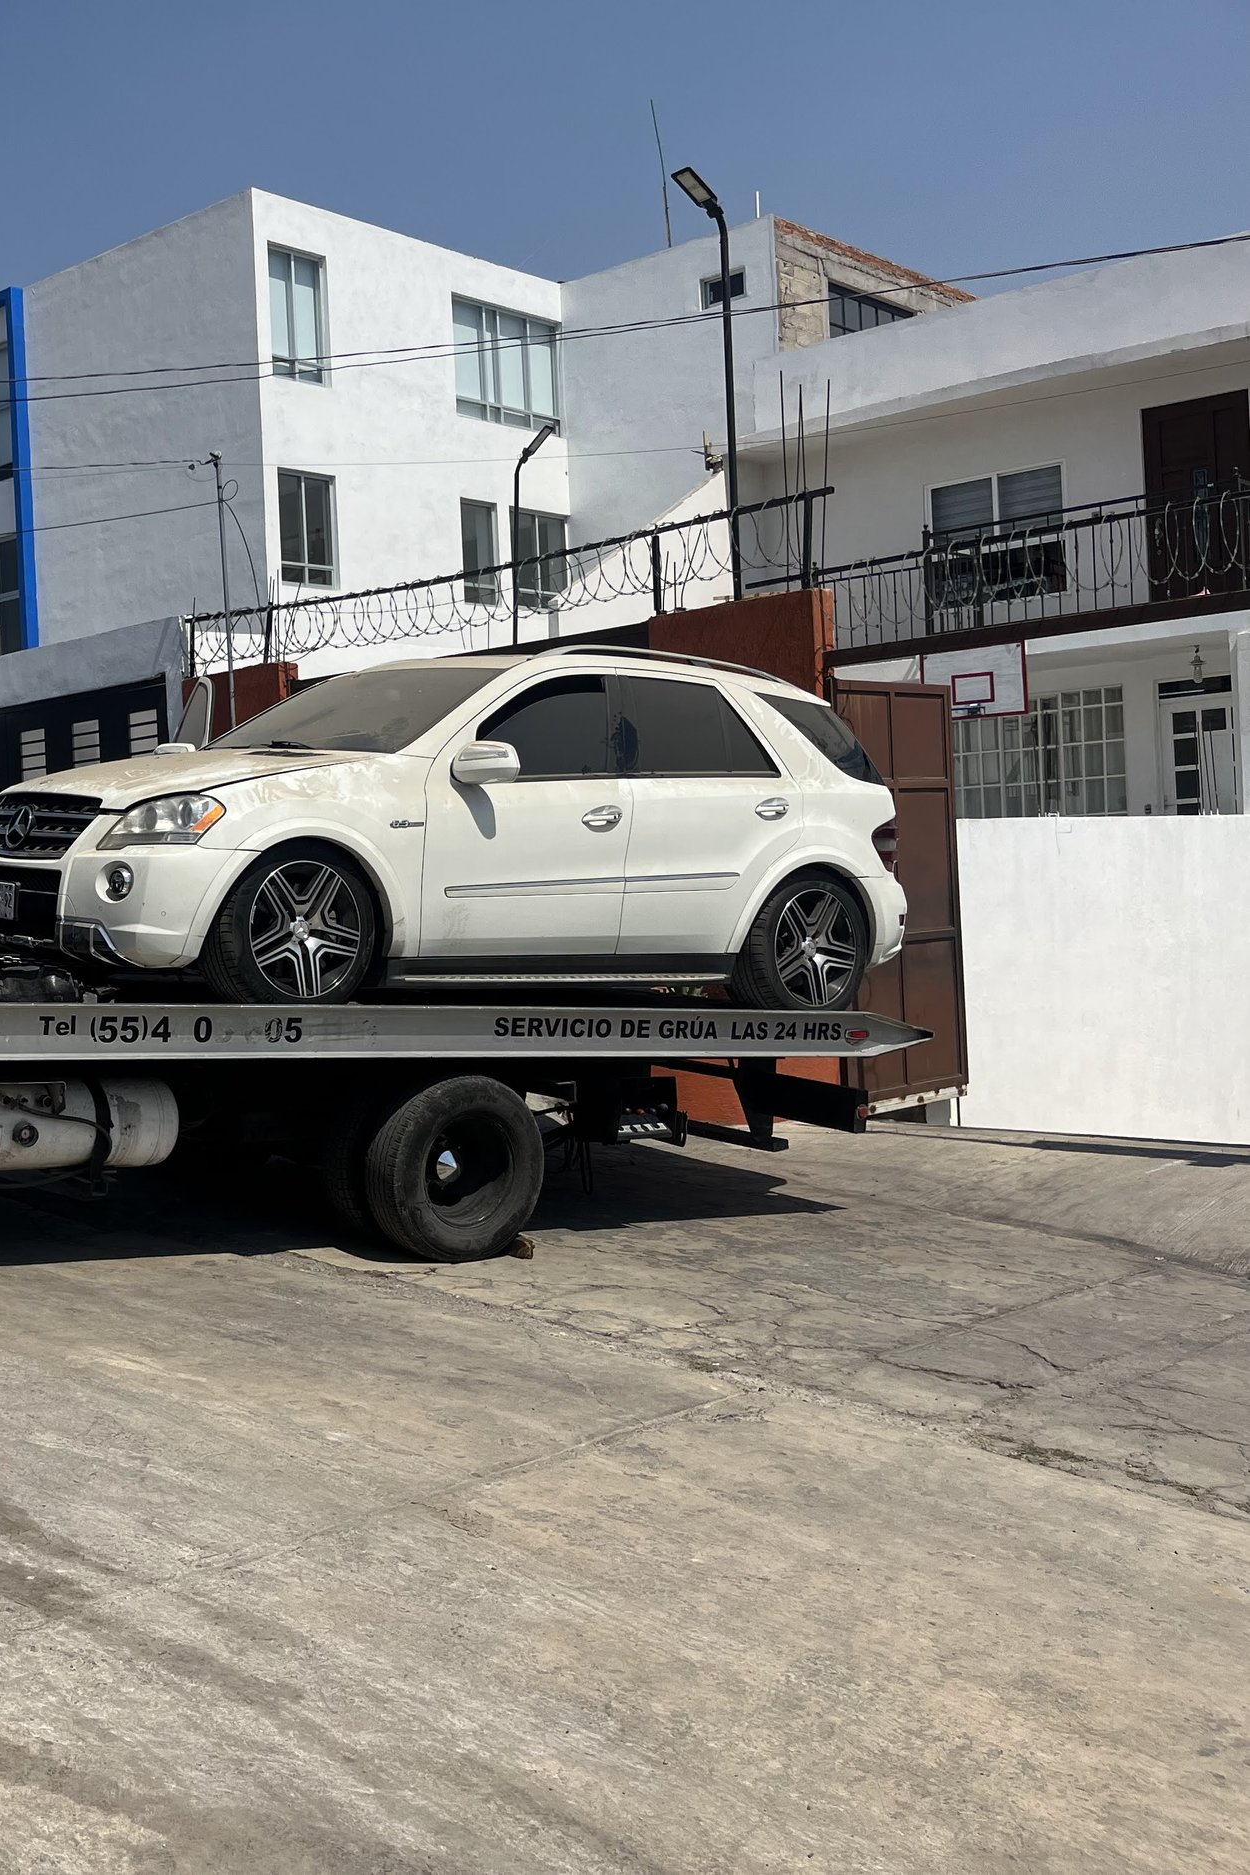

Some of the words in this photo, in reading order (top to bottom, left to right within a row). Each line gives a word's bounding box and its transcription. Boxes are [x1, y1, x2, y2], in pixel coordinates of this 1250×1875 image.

[39, 1015, 76, 1036] Tel
[493, 1016, 612, 1038] SERVICIO
[619, 1018, 650, 1039] DE
[658, 1015, 718, 1040] GRÚA
[730, 1021, 768, 1041] LAS
[773, 1021, 796, 1041] 24
[803, 1022, 842, 1042] HRS
